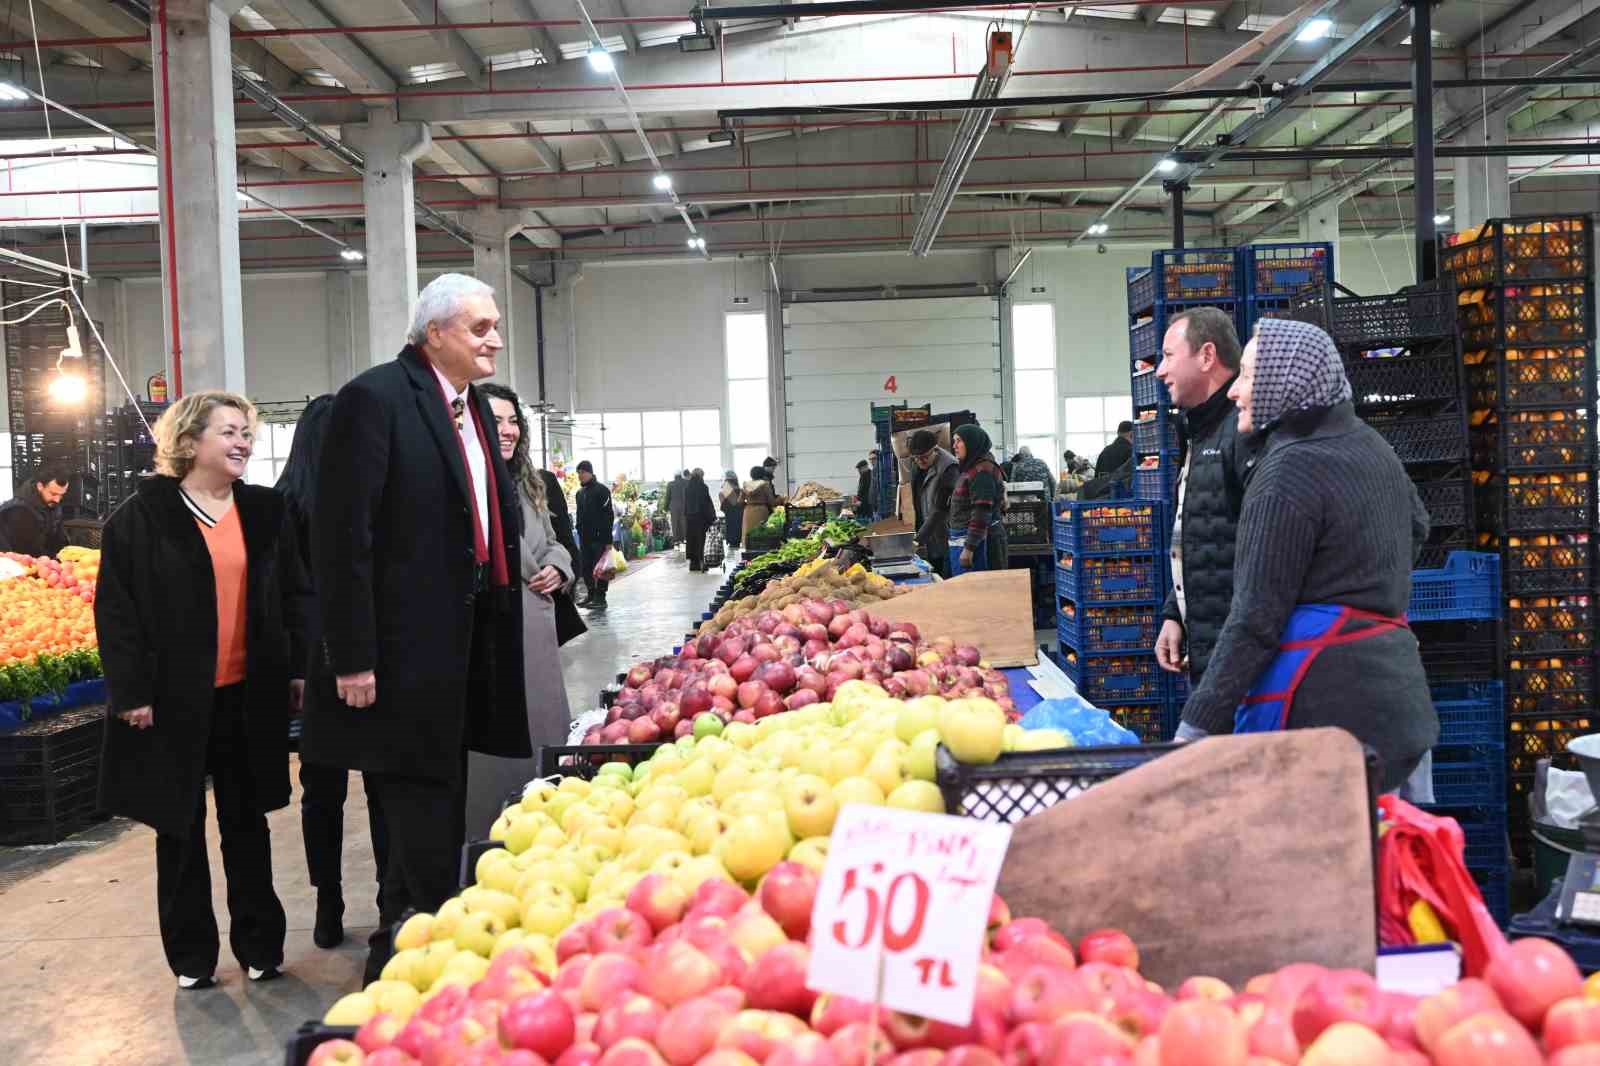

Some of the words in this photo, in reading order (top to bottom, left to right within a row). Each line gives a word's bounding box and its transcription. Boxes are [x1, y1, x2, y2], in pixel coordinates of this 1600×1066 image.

[884, 375, 898, 394] 4
[832, 862, 931, 953] 50
[915, 957, 956, 988] TL
